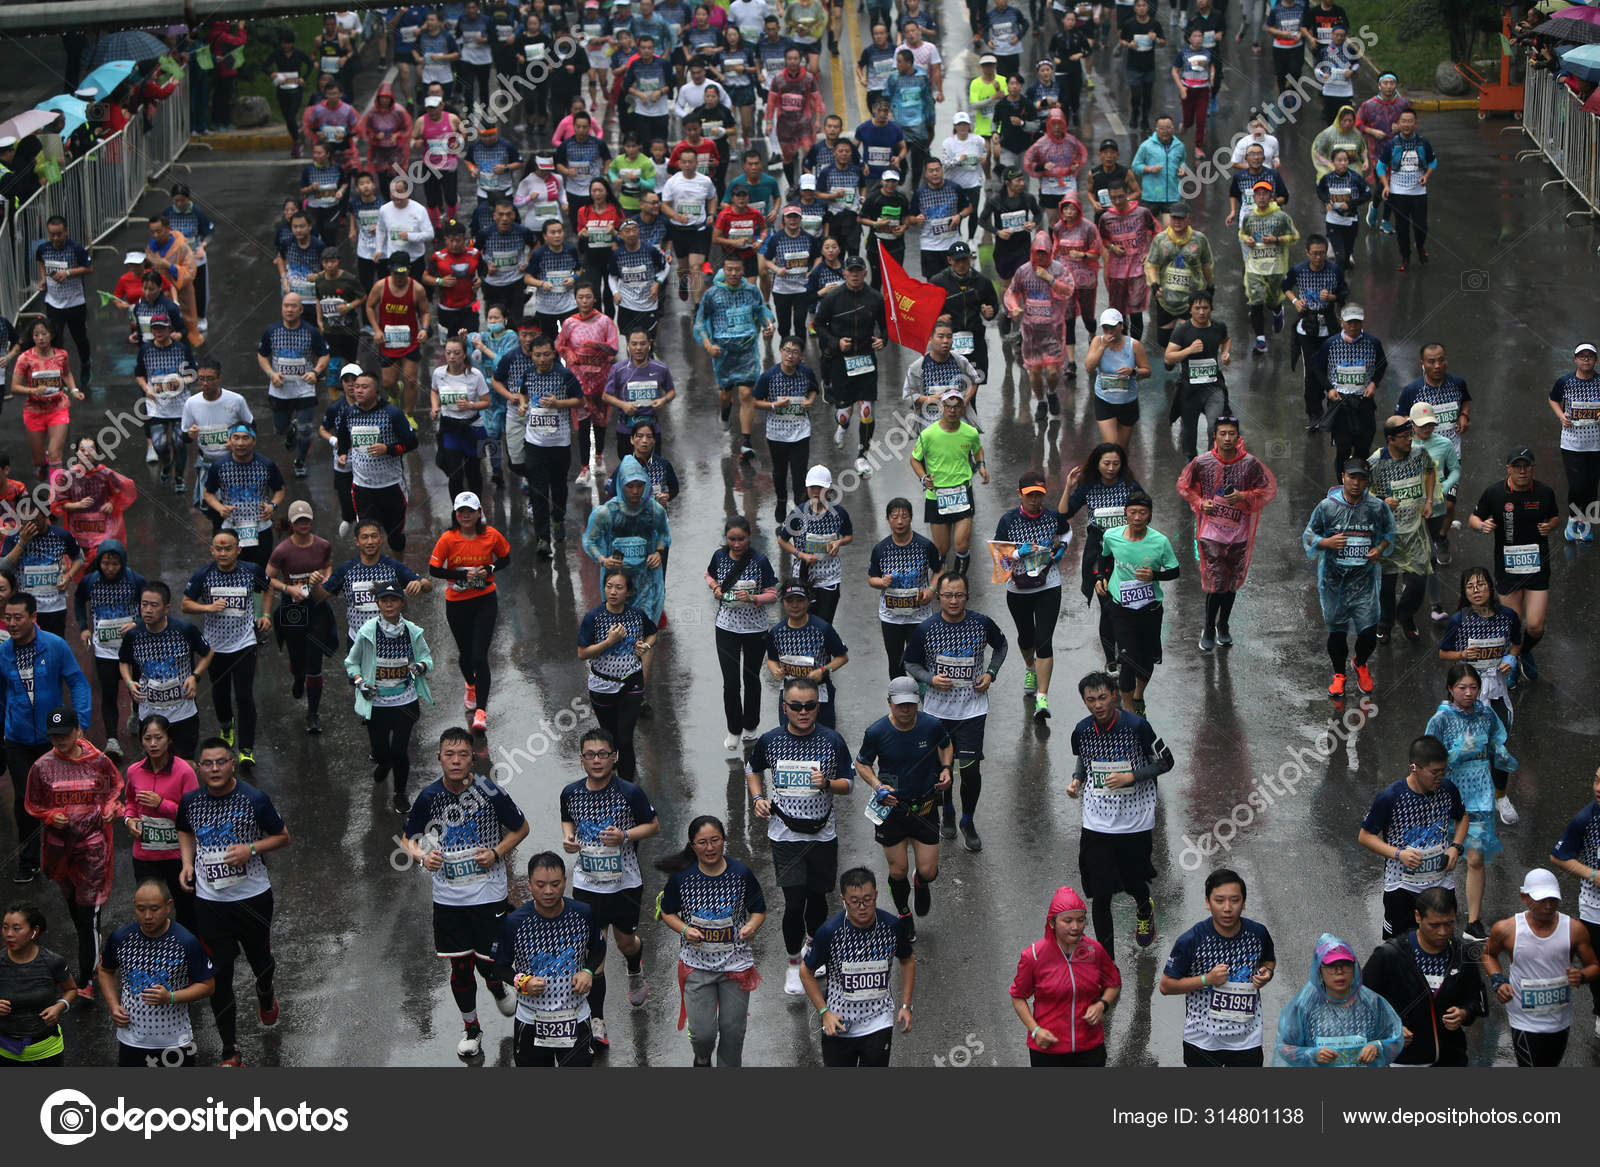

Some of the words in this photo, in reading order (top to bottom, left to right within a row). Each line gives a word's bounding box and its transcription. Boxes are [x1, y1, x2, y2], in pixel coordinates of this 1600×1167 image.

[385, 304, 408, 313] CHINA
[352, 435, 379, 446] F82337
[1506, 553, 1538, 566] E16057
[26, 576, 57, 586] E17646
[1121, 586, 1154, 602] E52815
[937, 664, 972, 678] E53850
[148, 688, 180, 700] E53648
[779, 772, 811, 786] E1236
[143, 829, 177, 841] F85196
[583, 857, 617, 870] E11246
[844, 973, 886, 989] E50091
[1212, 992, 1254, 1010] E51994
[1524, 988, 1567, 1006] E18898
[535, 1020, 577, 1037] E52347
